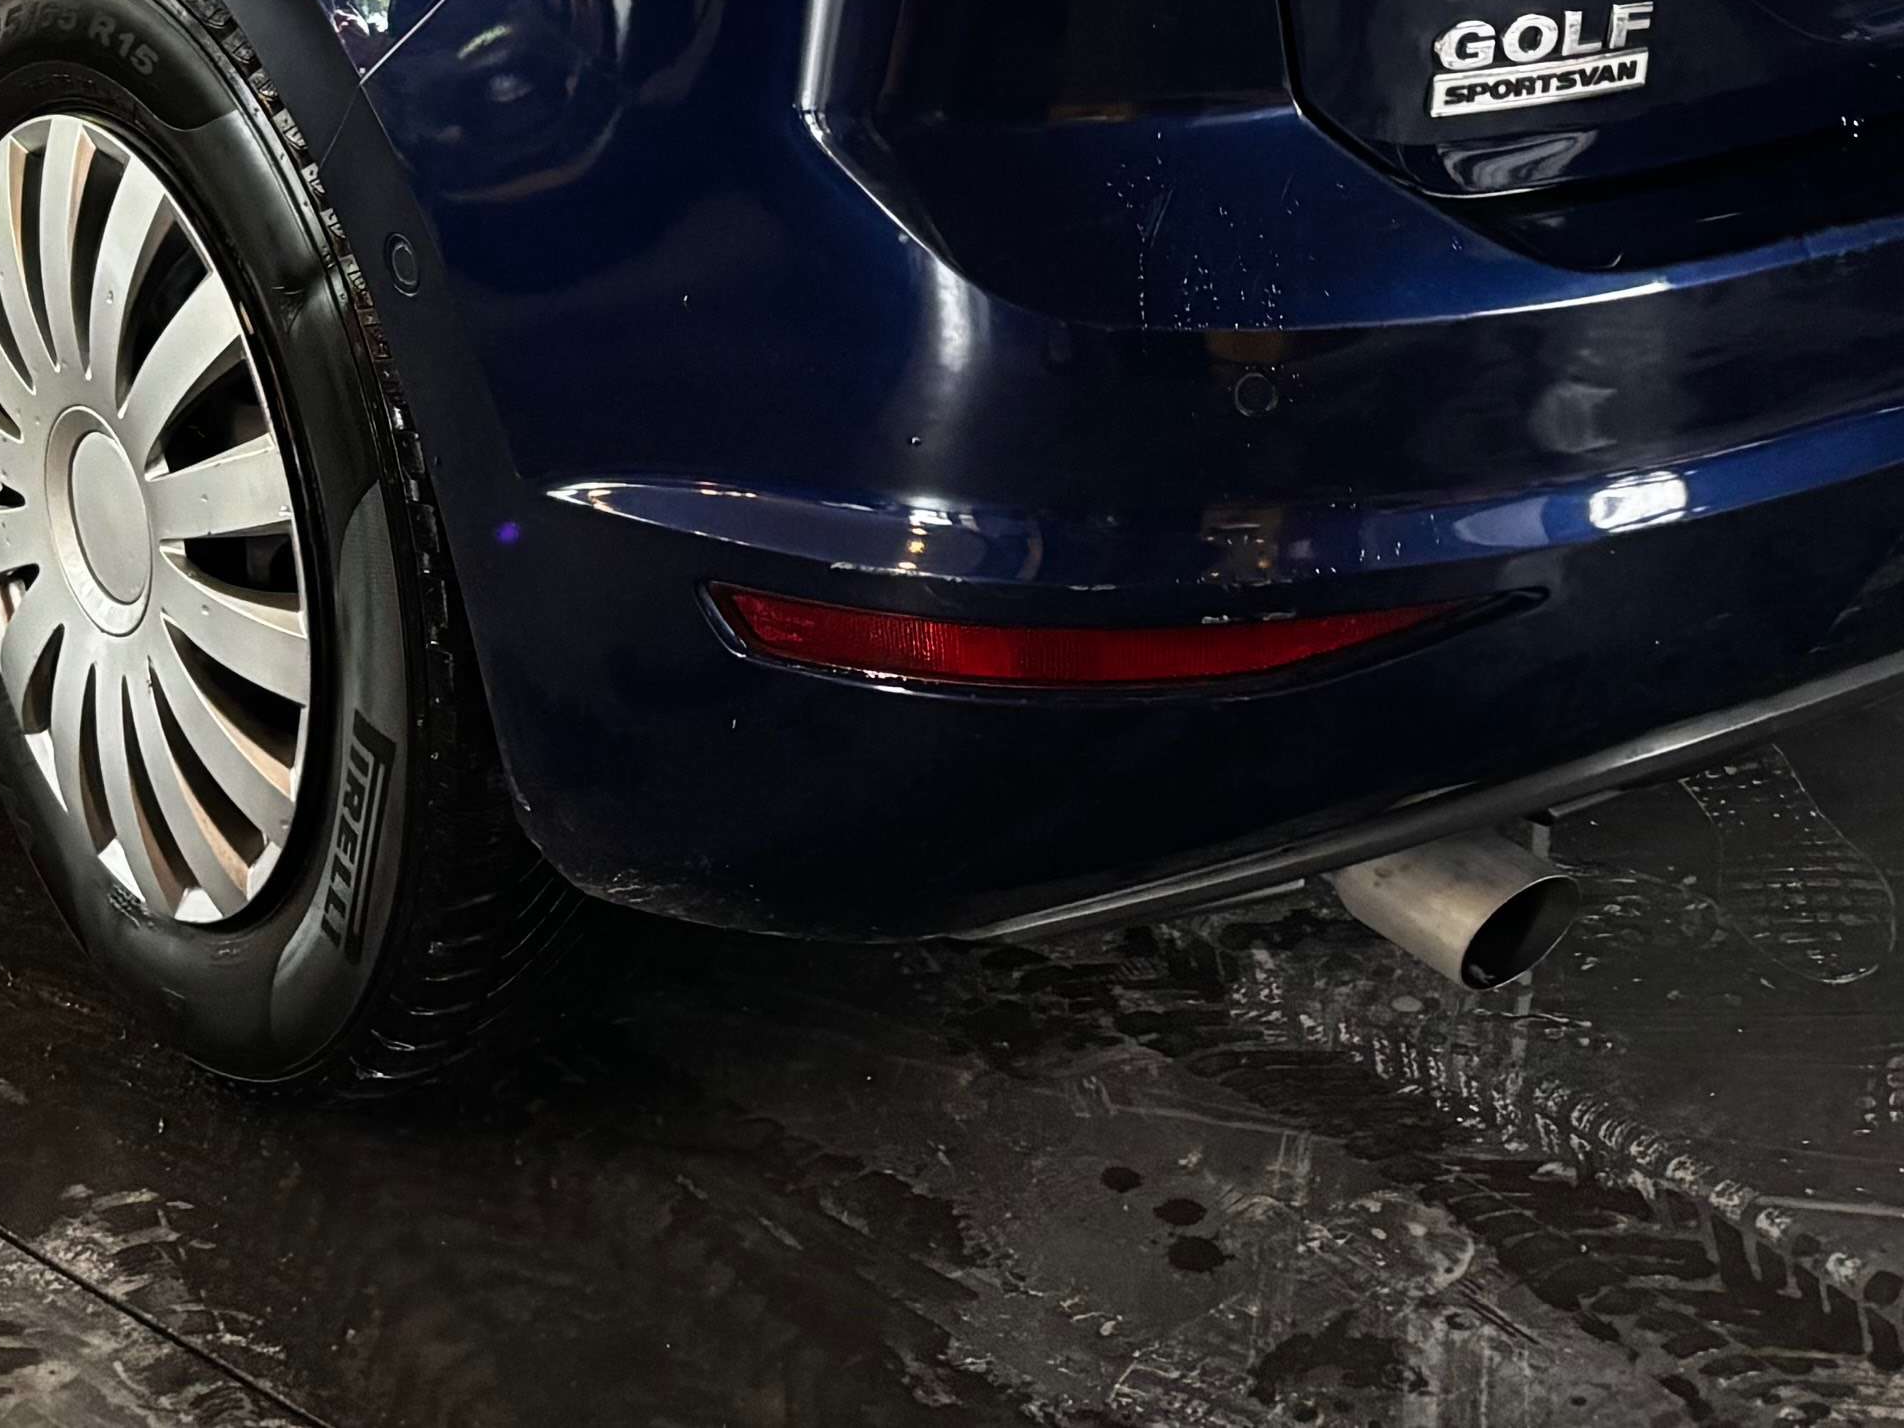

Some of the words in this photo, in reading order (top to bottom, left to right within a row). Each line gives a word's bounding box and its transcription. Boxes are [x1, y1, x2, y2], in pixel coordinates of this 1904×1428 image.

[1433, 1, 1654, 71] GOLF
[1443, 59, 1639, 106] SPORTSVAN
[320, 707, 397, 965] PIRELLI
